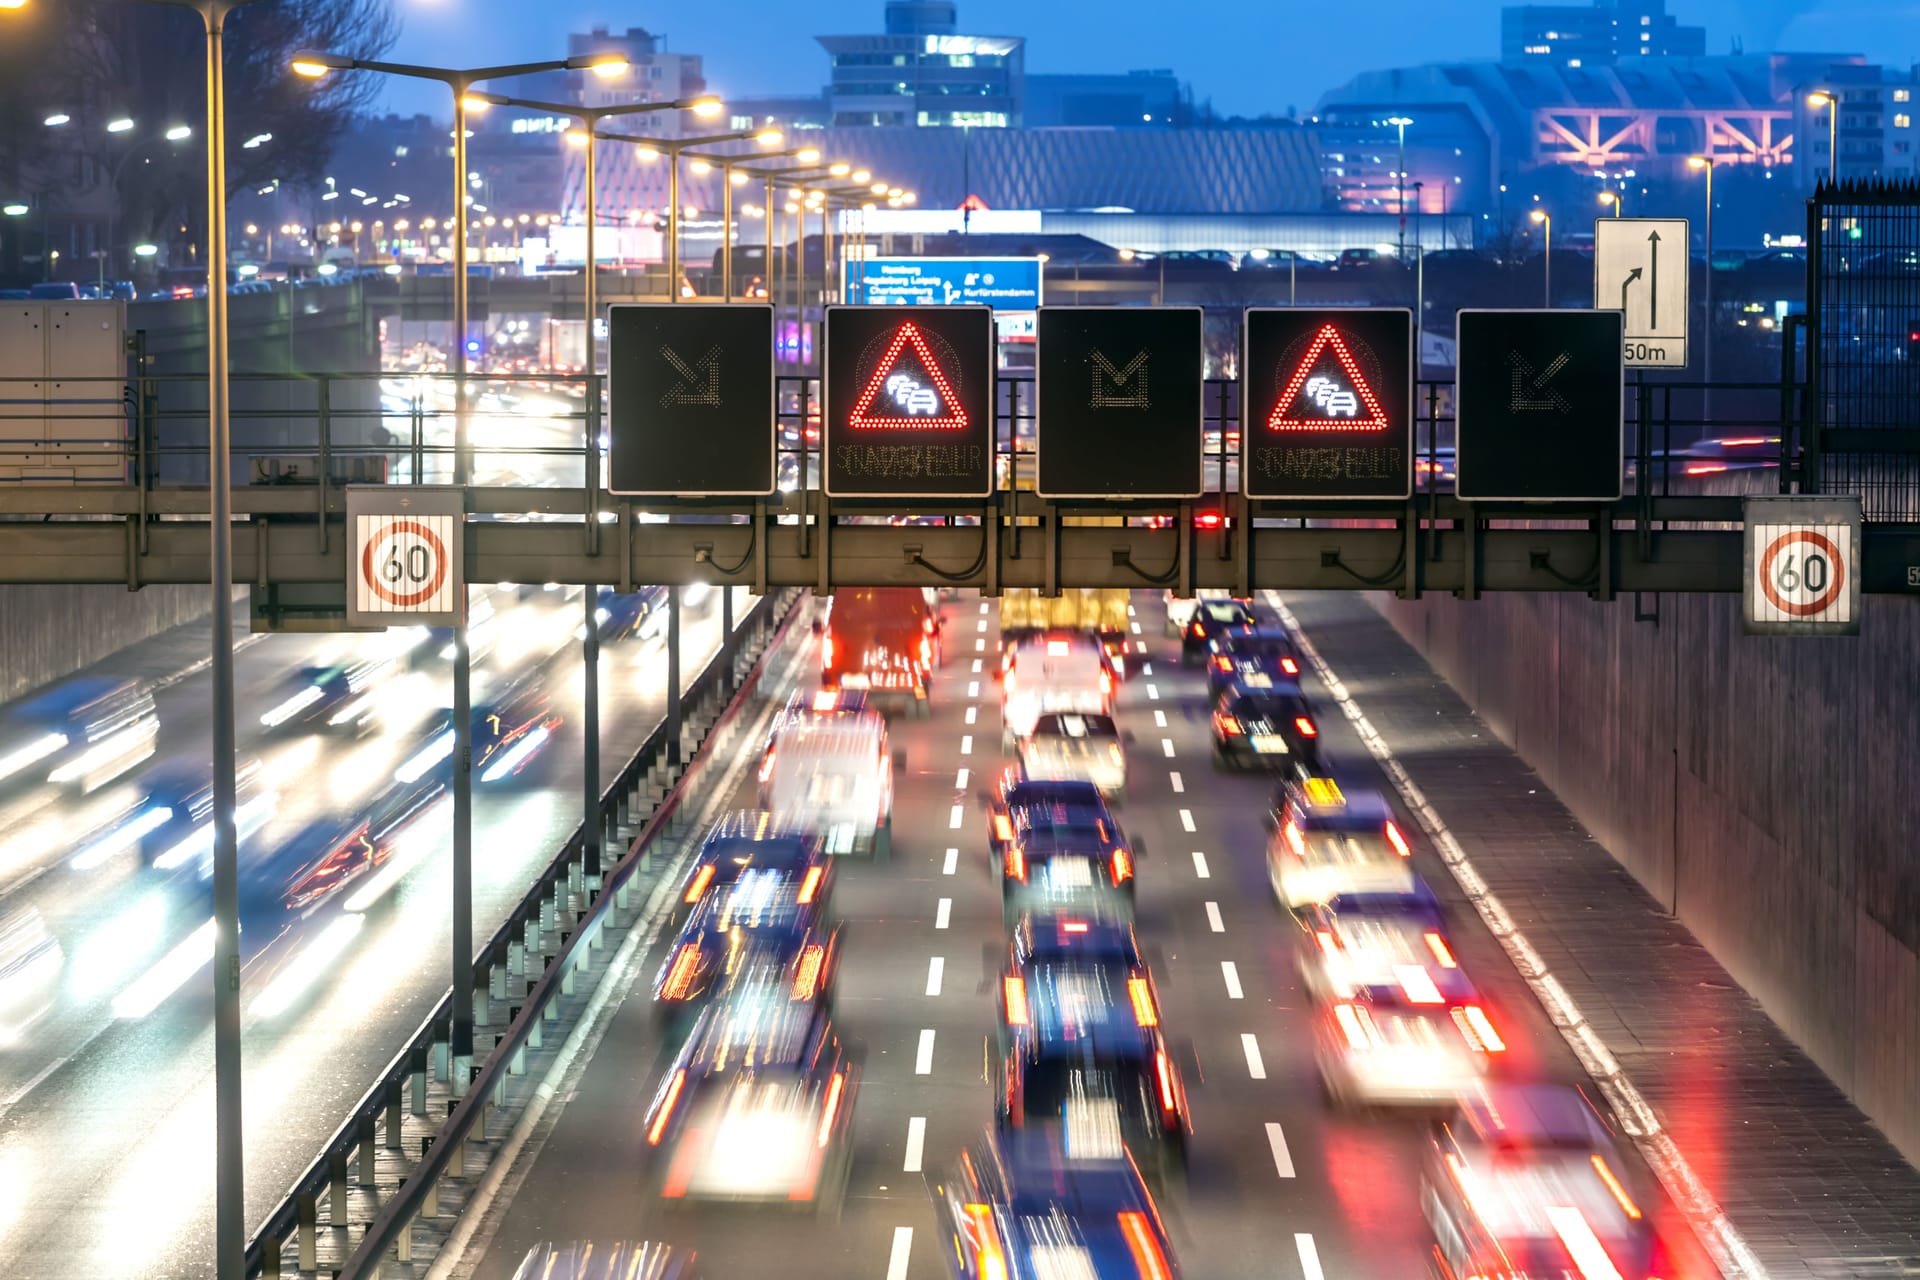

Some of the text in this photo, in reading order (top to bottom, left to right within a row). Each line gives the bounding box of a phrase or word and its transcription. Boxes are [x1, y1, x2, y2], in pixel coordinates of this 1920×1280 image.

[881, 265, 921, 276] Hamburg
[869, 286, 933, 297] Charlottenburg
[963, 287, 1036, 297] Kurfürstendamm
[382, 545, 430, 583] 60
[1777, 554, 1827, 593] 60
